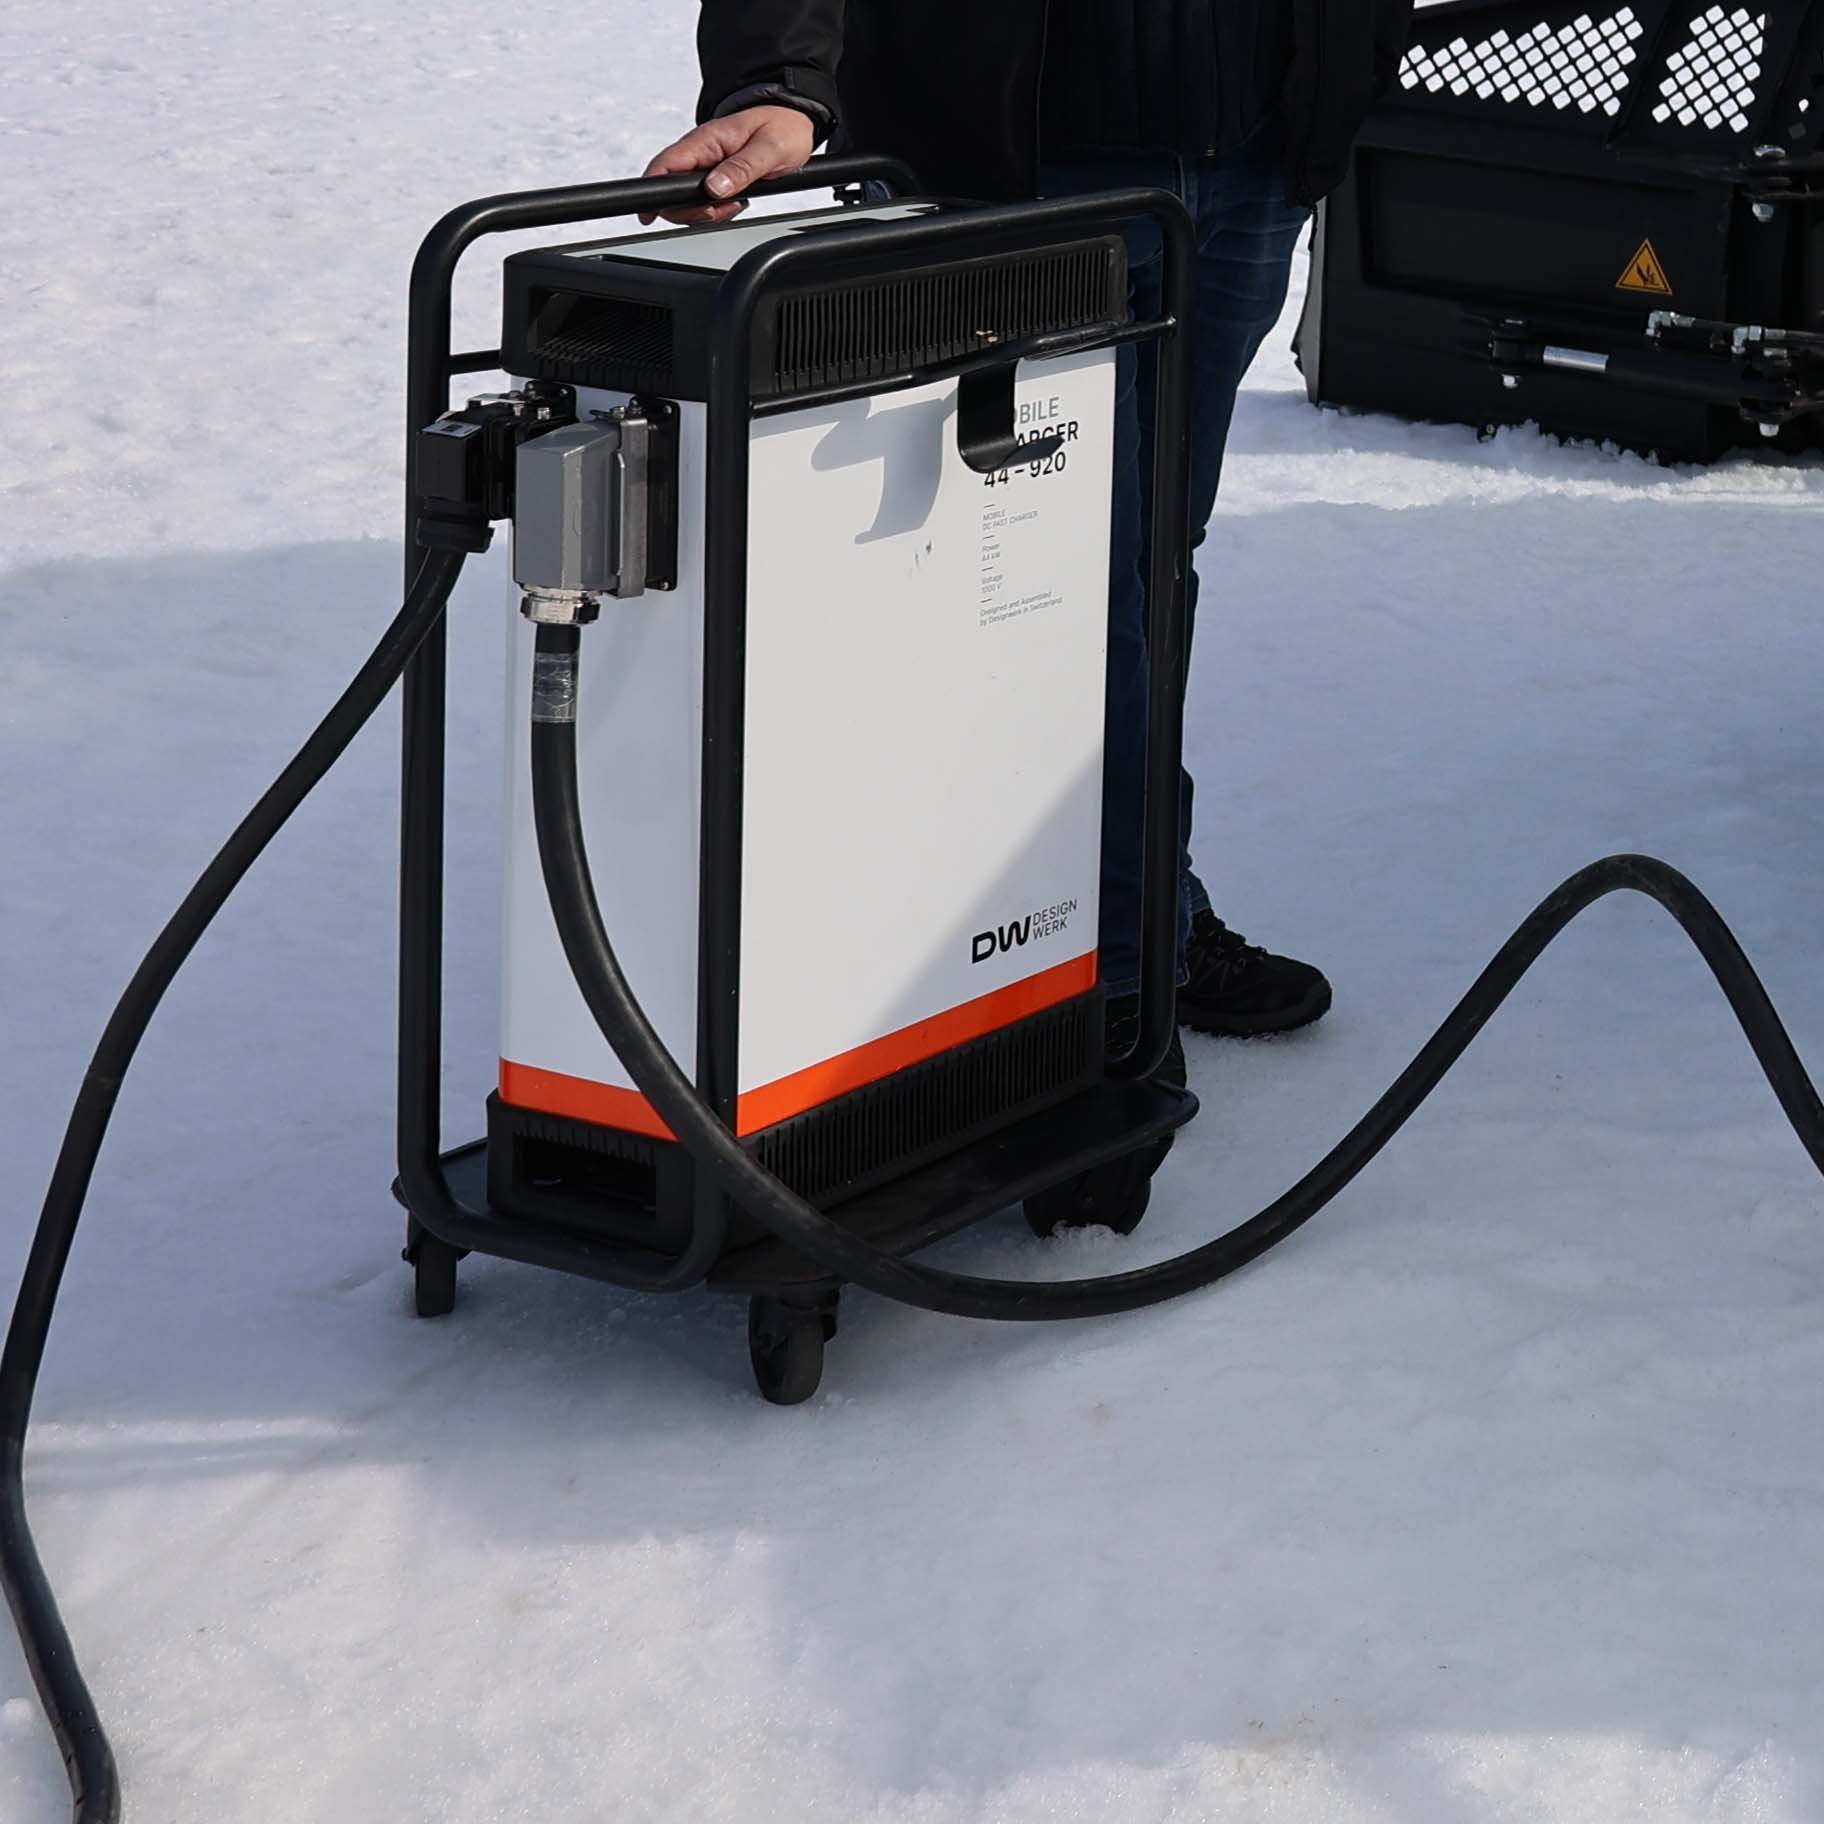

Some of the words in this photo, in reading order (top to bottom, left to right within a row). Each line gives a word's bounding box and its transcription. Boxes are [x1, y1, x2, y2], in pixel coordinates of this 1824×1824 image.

[1014, 396, 1060, 425] BILE
[971, 915, 1032, 965] DW
[1032, 898, 1079, 927] DESIGN
[1032, 916, 1069, 941] WERK
